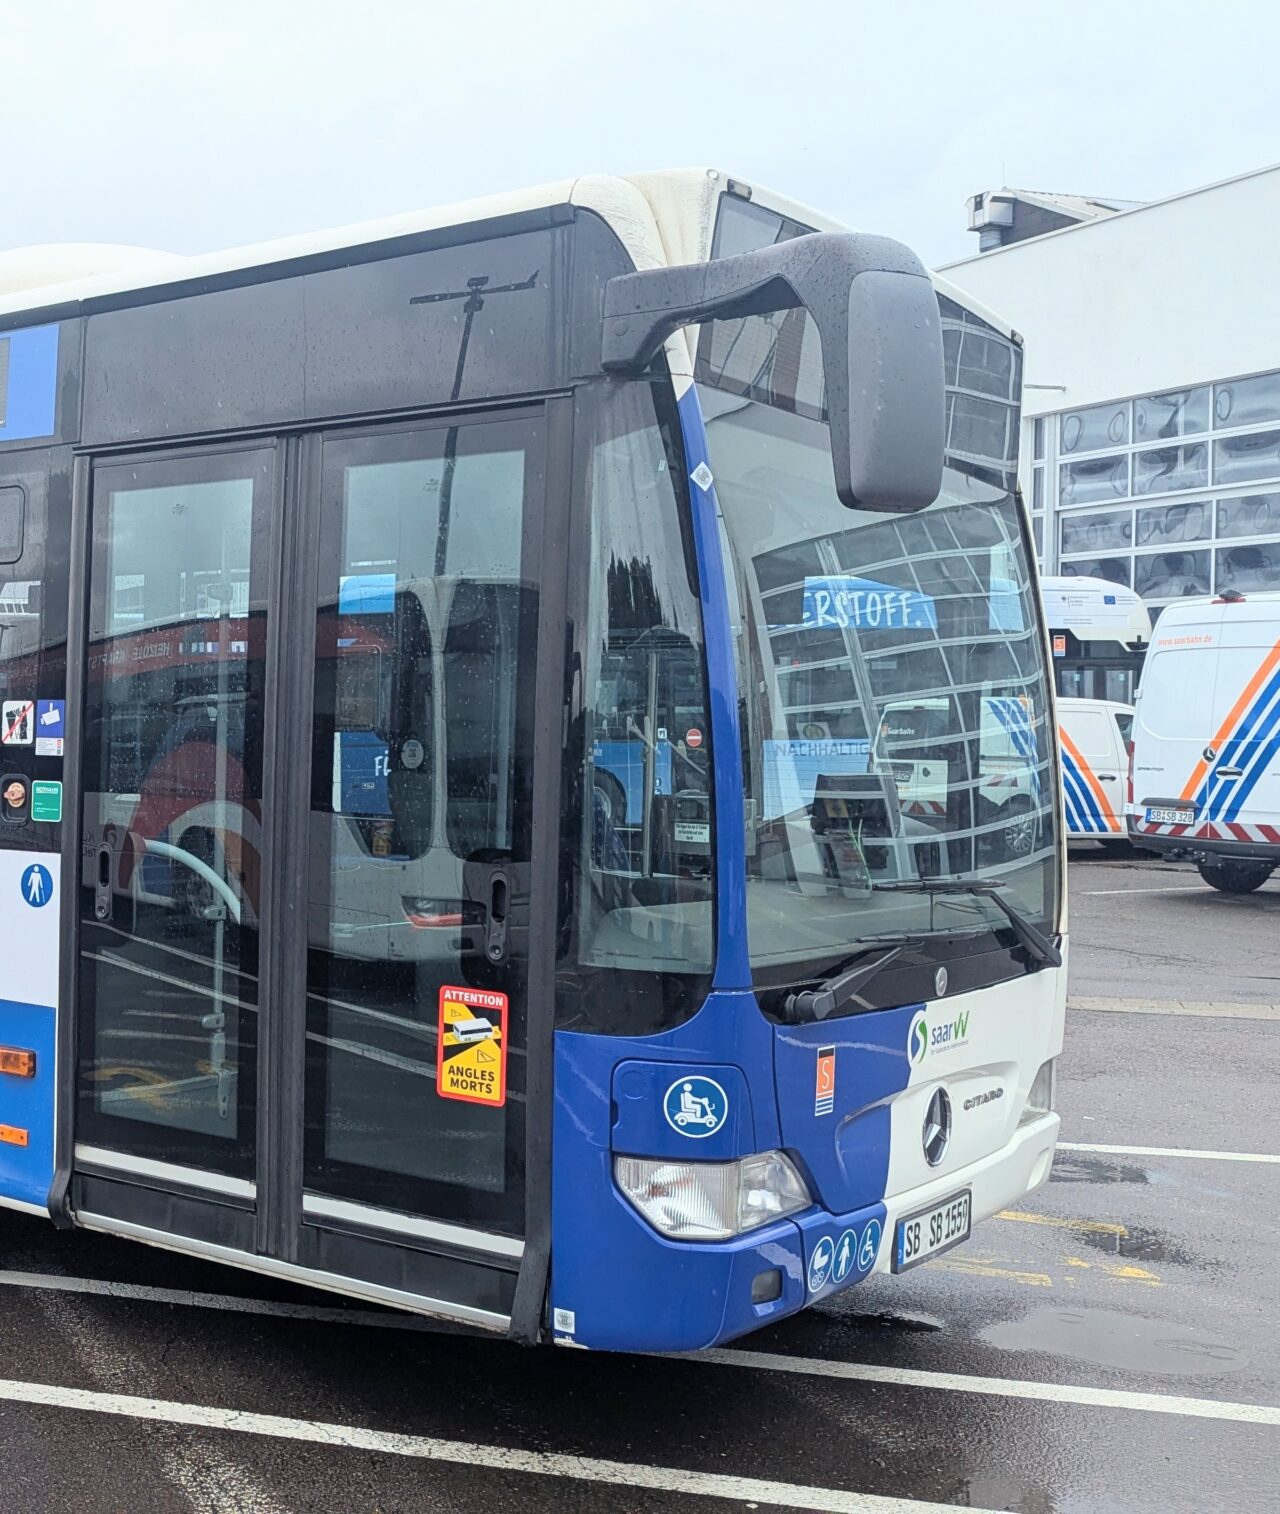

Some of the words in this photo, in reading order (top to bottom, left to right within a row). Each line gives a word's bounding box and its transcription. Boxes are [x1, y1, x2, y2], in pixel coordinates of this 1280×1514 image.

[1151, 811, 1161, 820] SB
[1166, 812, 1176, 821] SB
[1178, 812, 1193, 823] 328
[444, 989, 504, 1007] ATTENTION
[448, 1065, 495, 1082] ANGLES
[450, 1077, 493, 1094] MORTS
[963, 1087, 1004, 1111] CITARO
[906, 1222, 921, 1258] SB
[929, 1212, 943, 1247] SB
[945, 1198, 968, 1240] 1559
